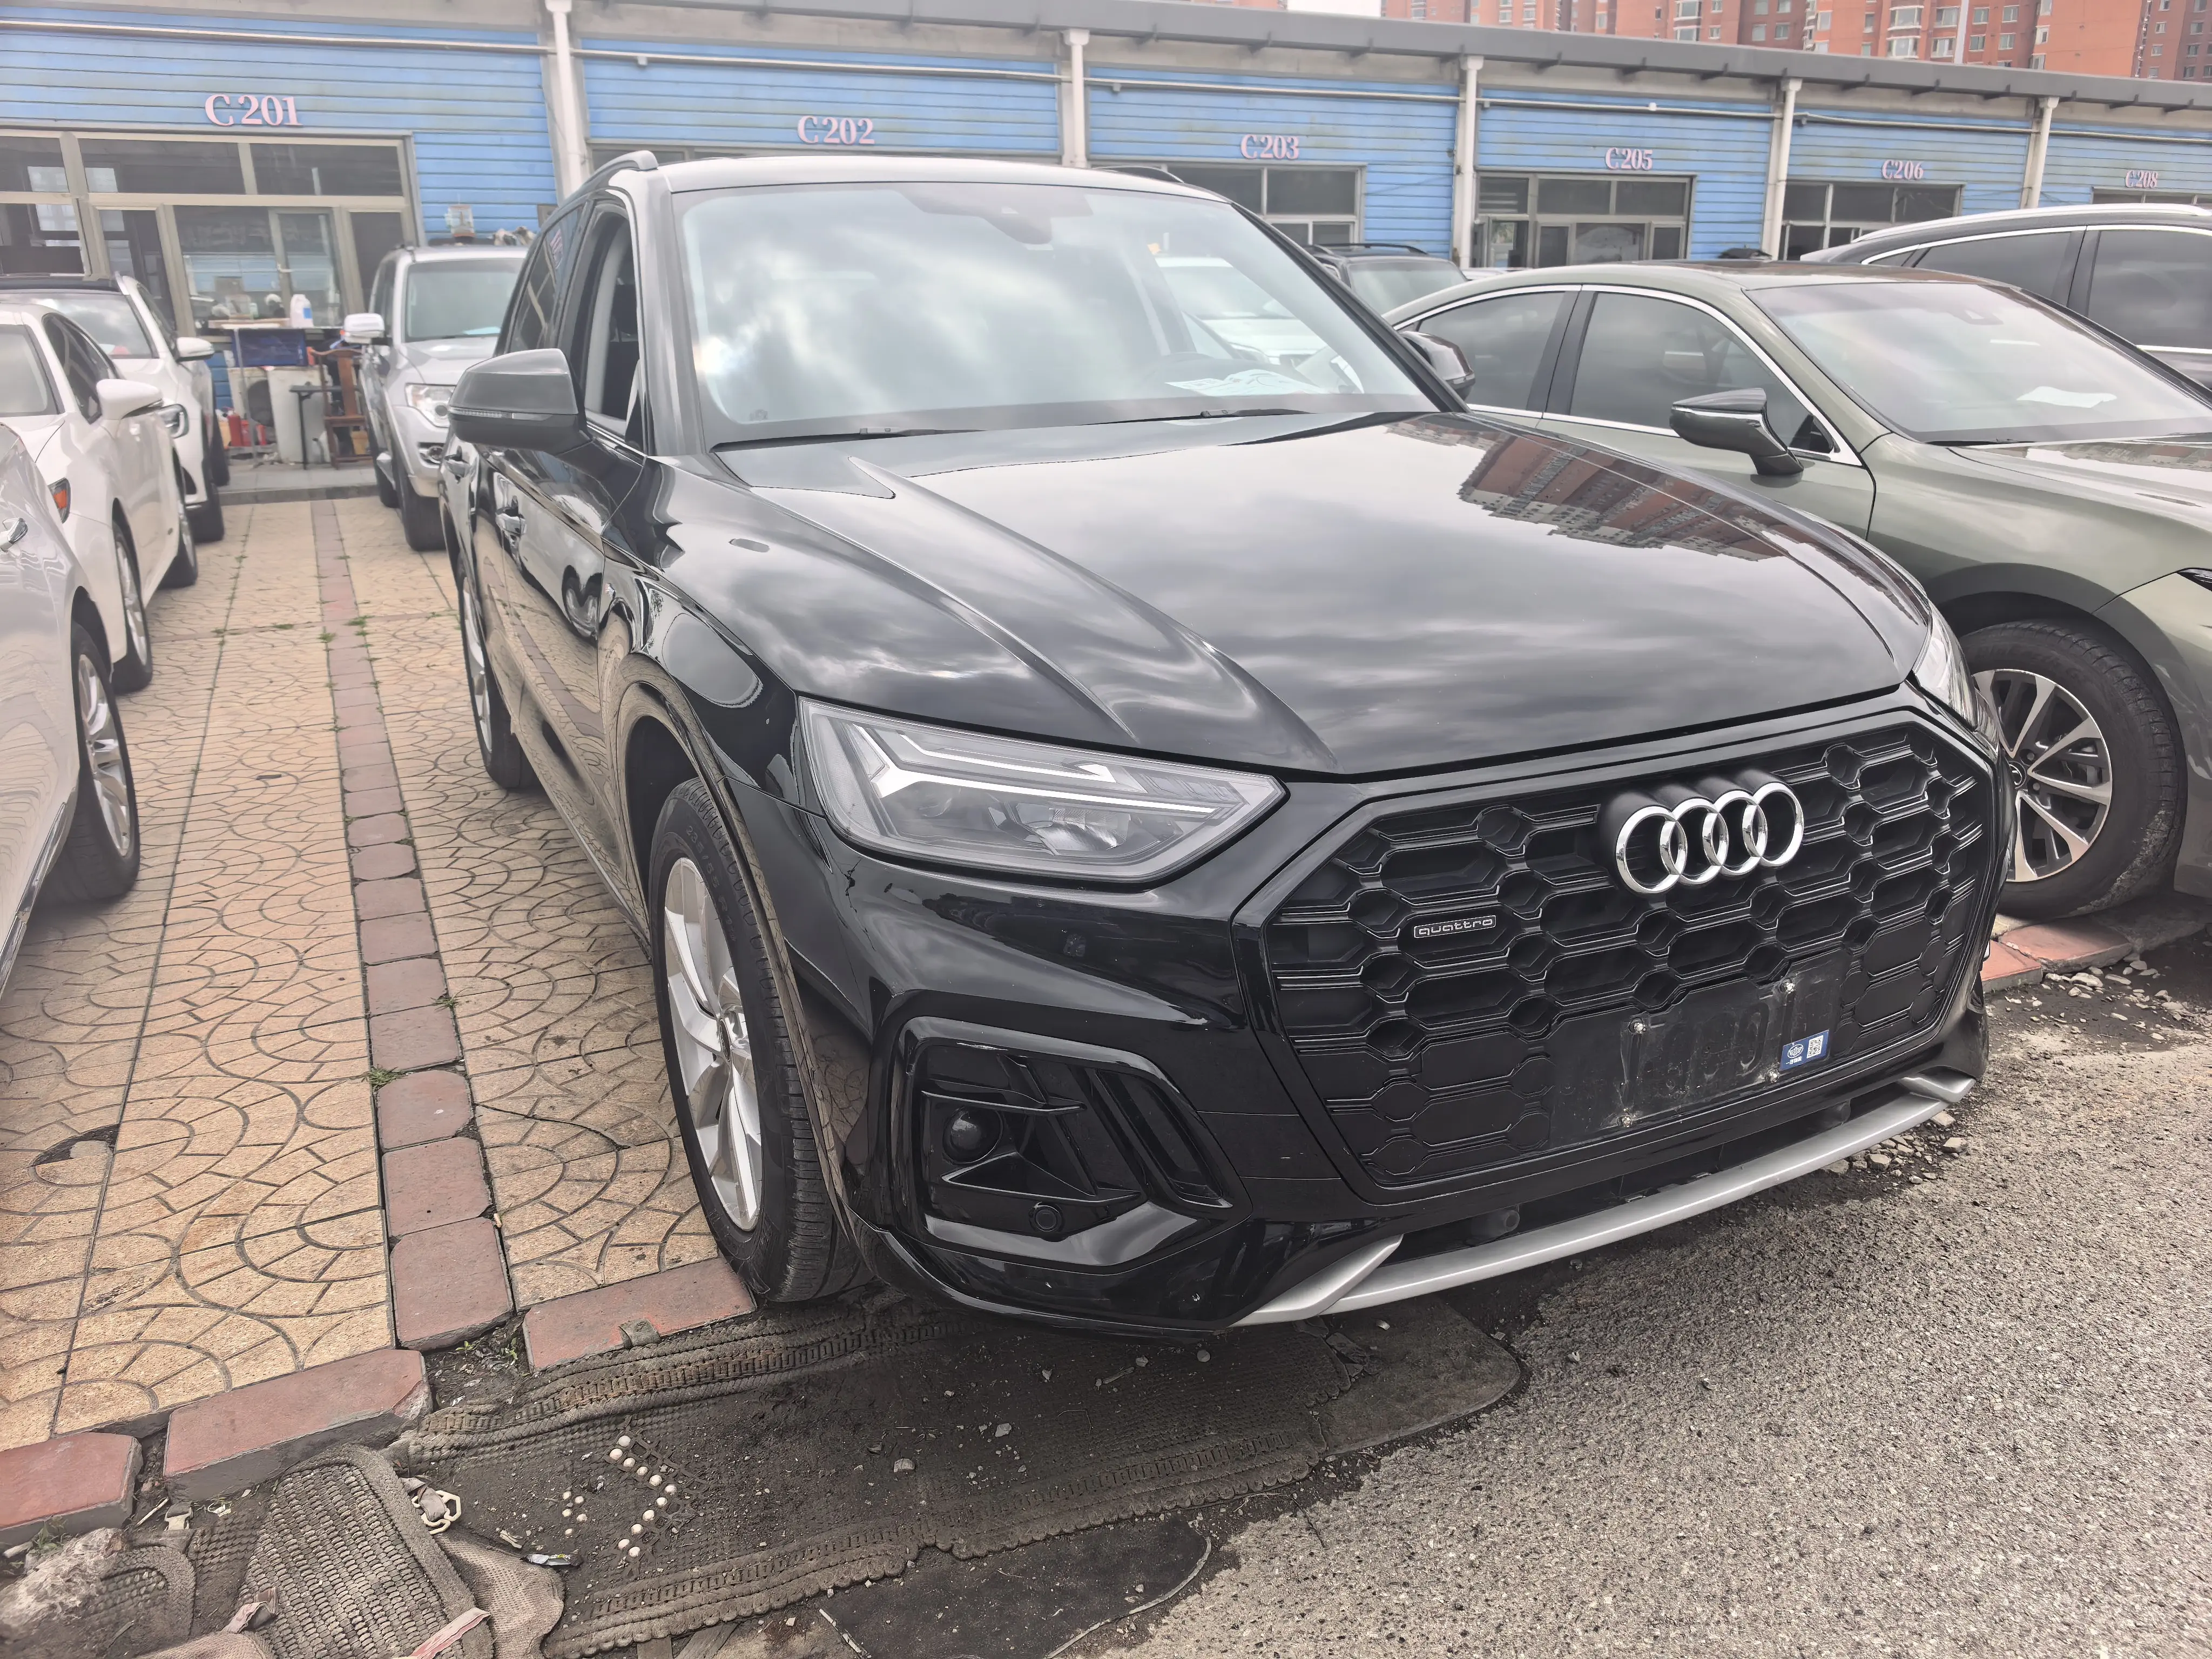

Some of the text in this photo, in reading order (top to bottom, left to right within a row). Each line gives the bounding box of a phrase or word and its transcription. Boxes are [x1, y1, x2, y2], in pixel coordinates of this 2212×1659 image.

[205, 94, 304, 126] C201
[798, 116, 875, 144] C202
[1240, 134, 1299, 159] C203
[1605, 147, 1653, 170] C205
[1882, 159, 1924, 180] C206
[2126, 170, 2159, 188] C208
[1419, 918, 1493, 935] quattro
